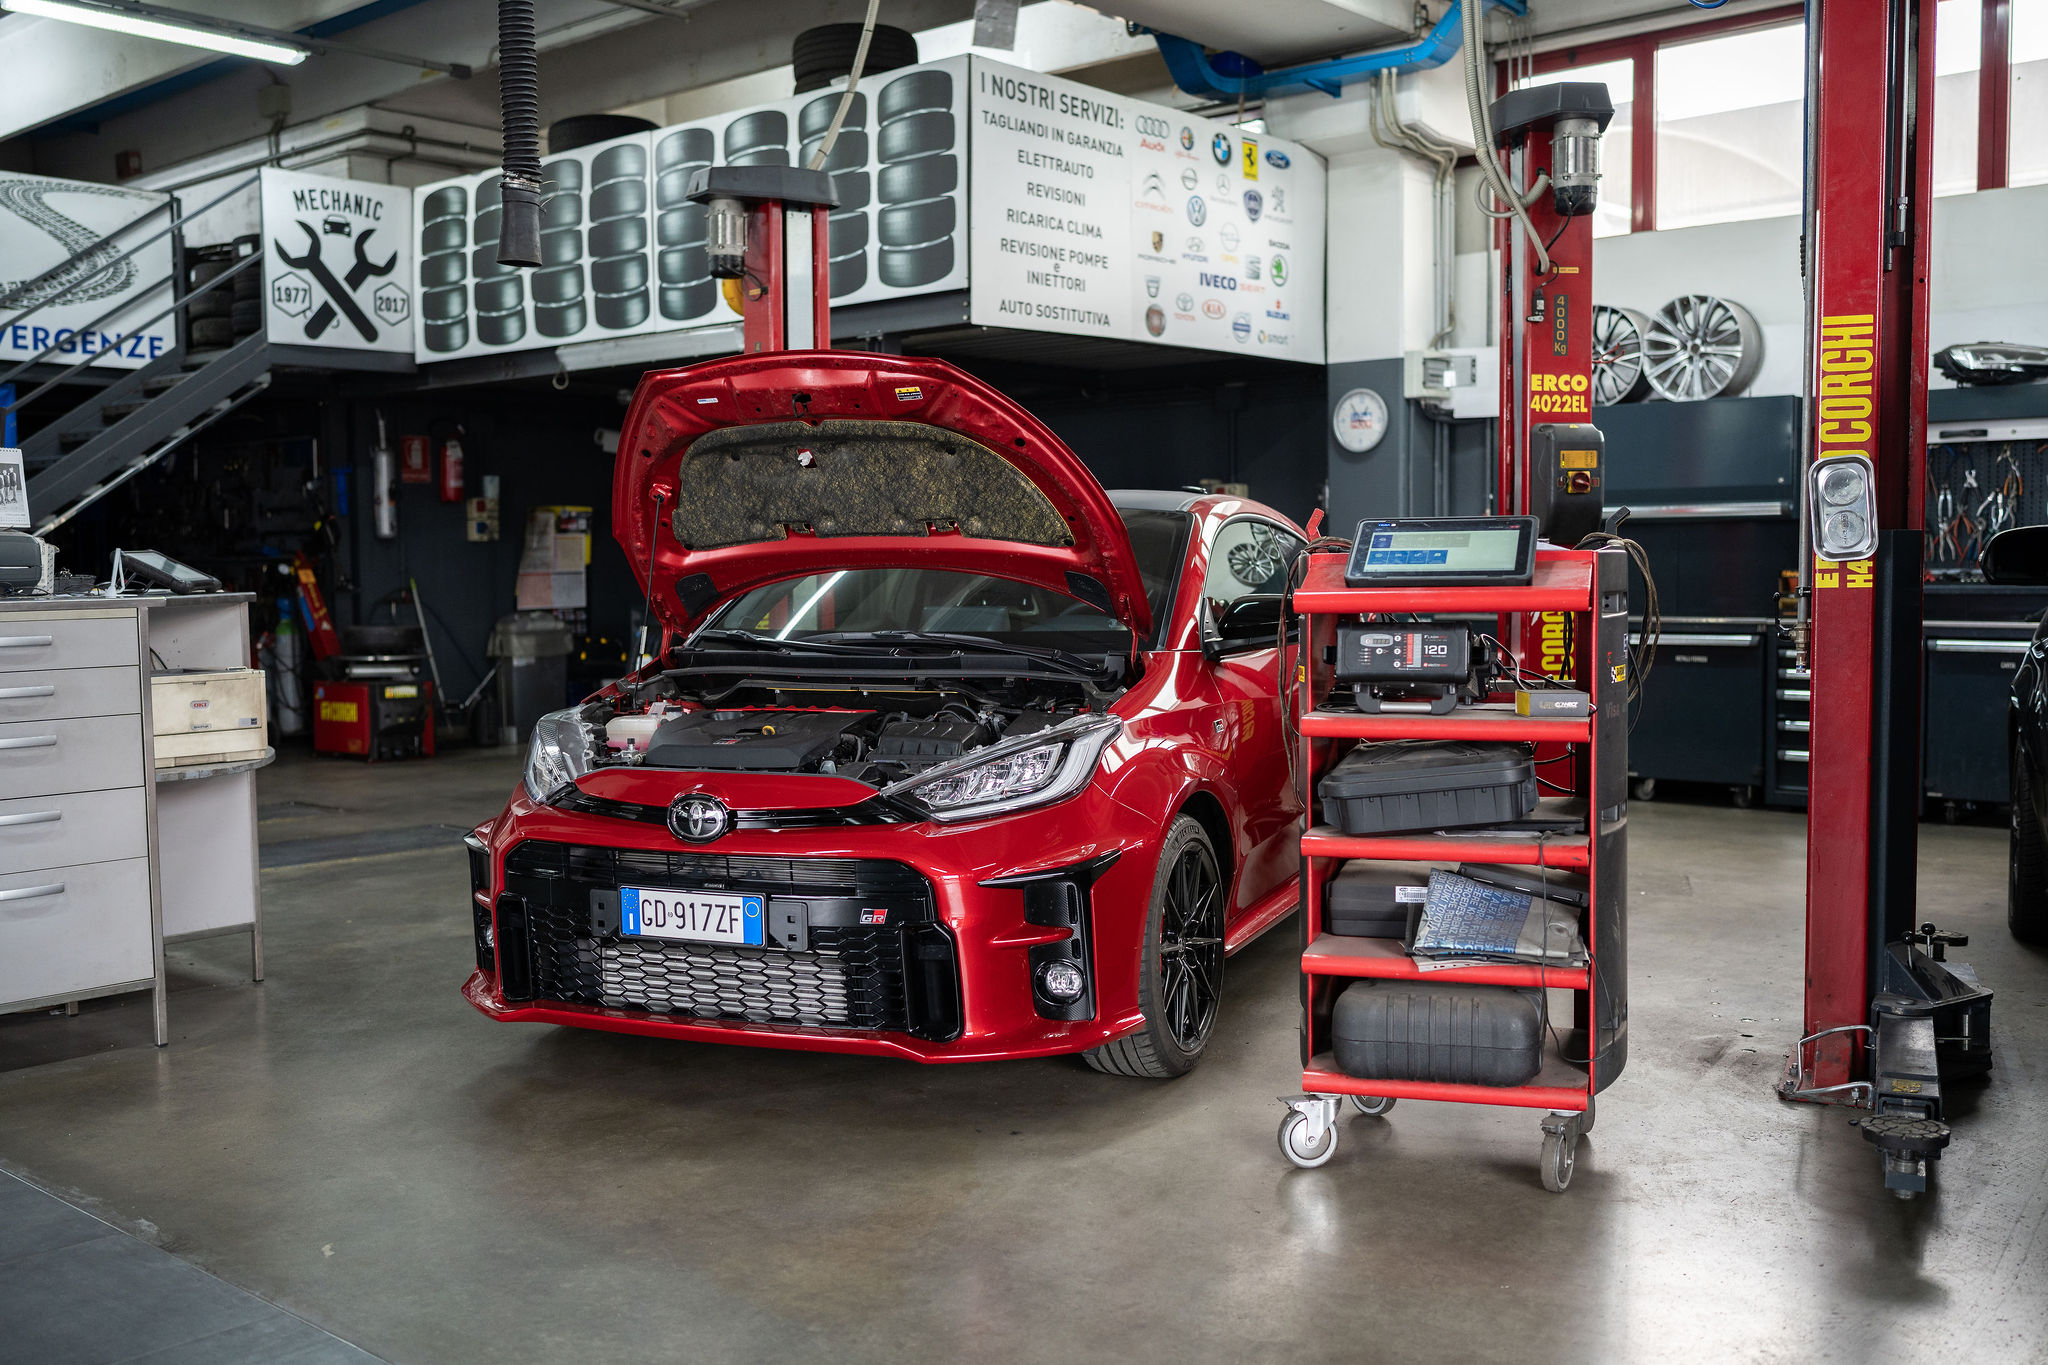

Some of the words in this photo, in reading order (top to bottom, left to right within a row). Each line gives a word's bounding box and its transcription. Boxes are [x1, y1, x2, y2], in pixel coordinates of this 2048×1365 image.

[981, 71, 985, 93] I
[992, 74, 1055, 111] NOSTRI
[1060, 92, 1124, 129] SERVIZI:
[982, 110, 1049, 139] TAGLIANDI
[1051, 127, 1064, 142] IN
[1067, 132, 1124, 158] GARANZIA
[1017, 149, 1094, 179] ELETTRAUTO
[293, 189, 384, 221] MECHANIC
[1027, 182, 1086, 207] REVISIONI
[1006, 208, 1064, 232] RICARICA
[1067, 220, 1103, 239] CLIMA
[1000, 238, 1066, 262] REVISIONE
[1069, 250, 1109, 270] POMPE
[1053, 263, 1060, 272] e
[1027, 270, 1086, 292] INIETTORI
[1199, 272, 1237, 291] IVECO
[276, 286, 308, 304] 1977
[377, 296, 406, 314] 2017
[999, 299, 1033, 316] AUTO
[1036, 304, 1111, 327] SOSTITUTIVA
[1531, 374, 1588, 392] ERCO
[1820, 313, 1874, 443] CORGHI
[1530, 394, 1588, 412] 4022EL
[1424, 645, 1447, 655] 120
[1429, 885, 1444, 904] BMW
[1439, 876, 1457, 902] SUZUKI
[674, 901, 741, 934] 917ZF
[861, 913, 886, 925] GR
[1429, 904, 1447, 930] TOYOTA
